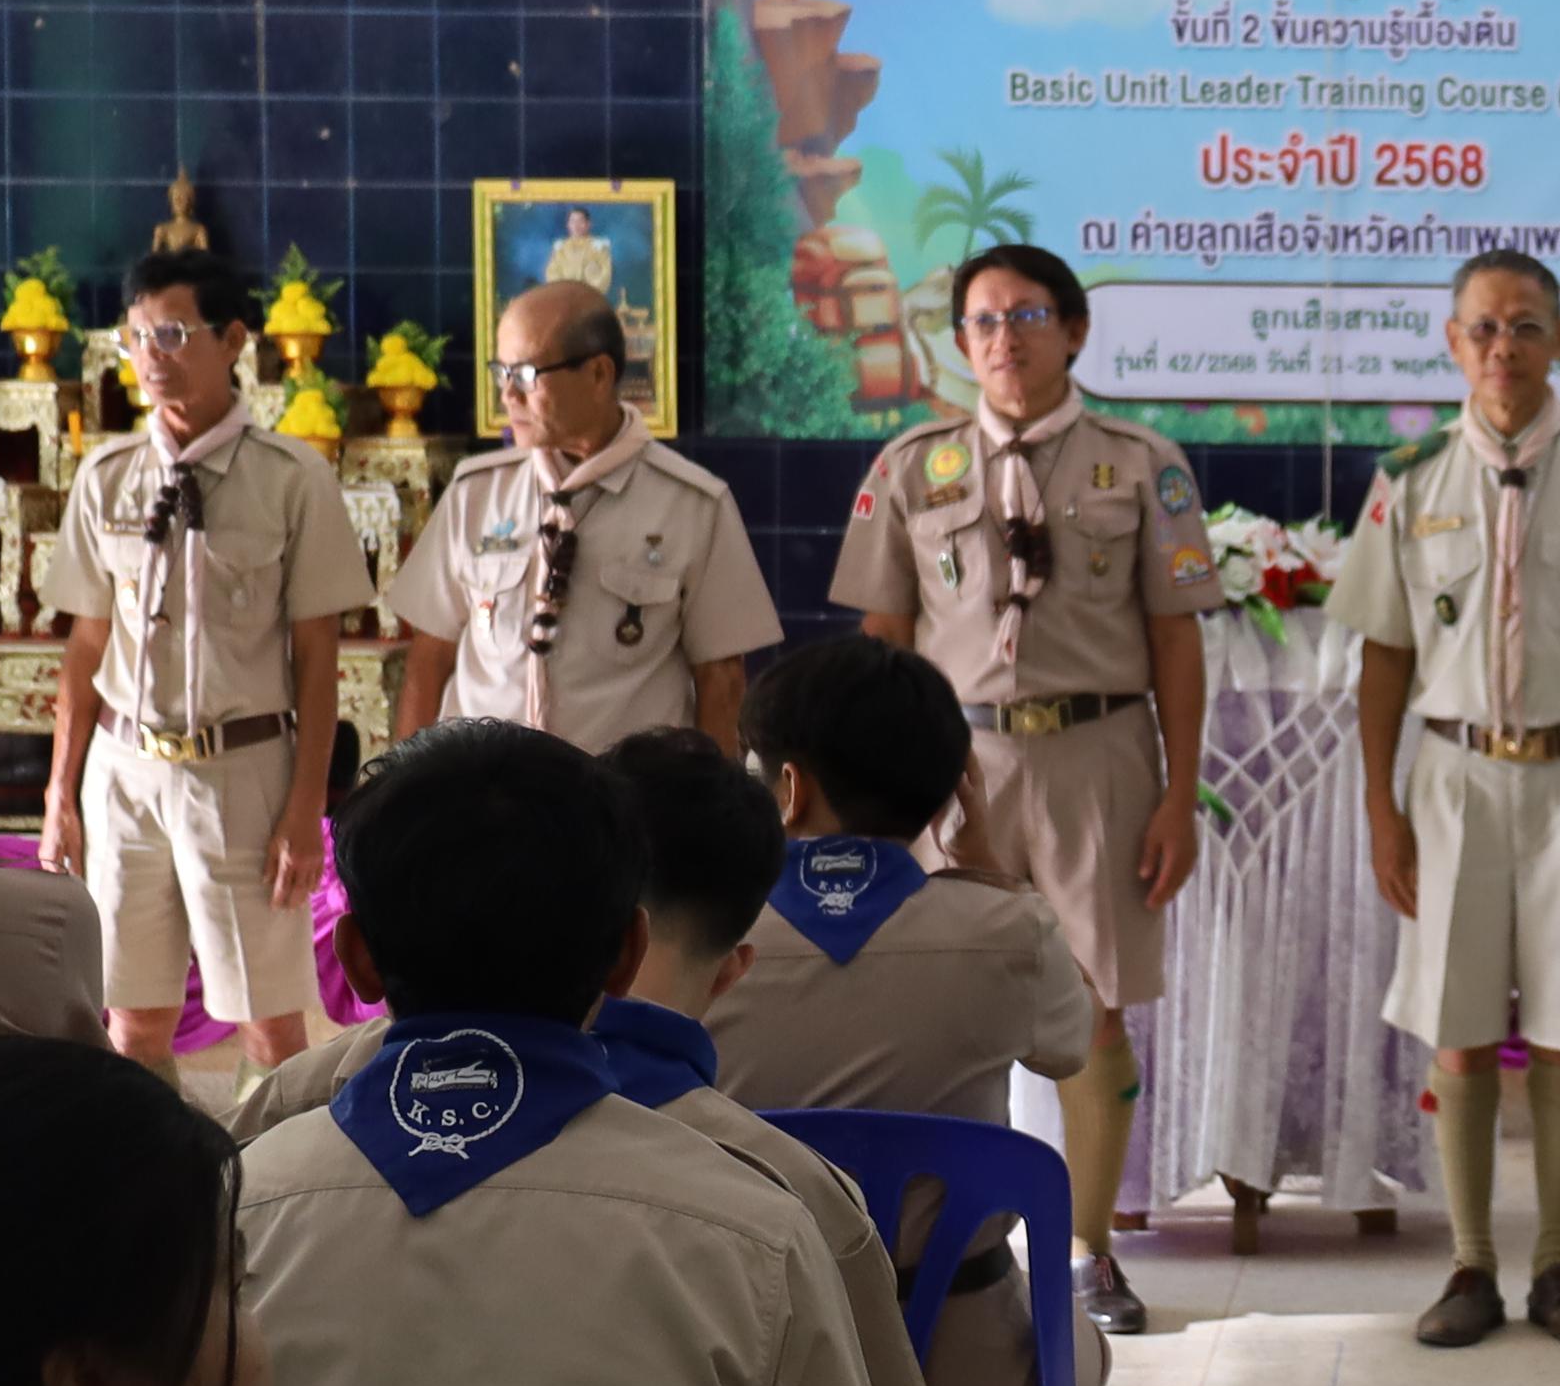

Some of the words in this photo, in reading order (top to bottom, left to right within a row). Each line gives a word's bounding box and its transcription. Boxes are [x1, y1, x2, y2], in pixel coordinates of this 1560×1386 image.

[1243, 15, 1259, 43] 2
[1272, 0, 1516, 59] ขั้นความรู้เบื้องต้น
[1010, 72, 1093, 102] Basic
[1104, 75, 1169, 104] Unit
[1180, 75, 1286, 105] Leader
[1297, 75, 1425, 114] Training
[1437, 76, 1546, 108] Course
[1202, 132, 1357, 186] ประจำปี
[1374, 143, 1485, 187] 2568
[1083, 220, 1117, 251] ณ
